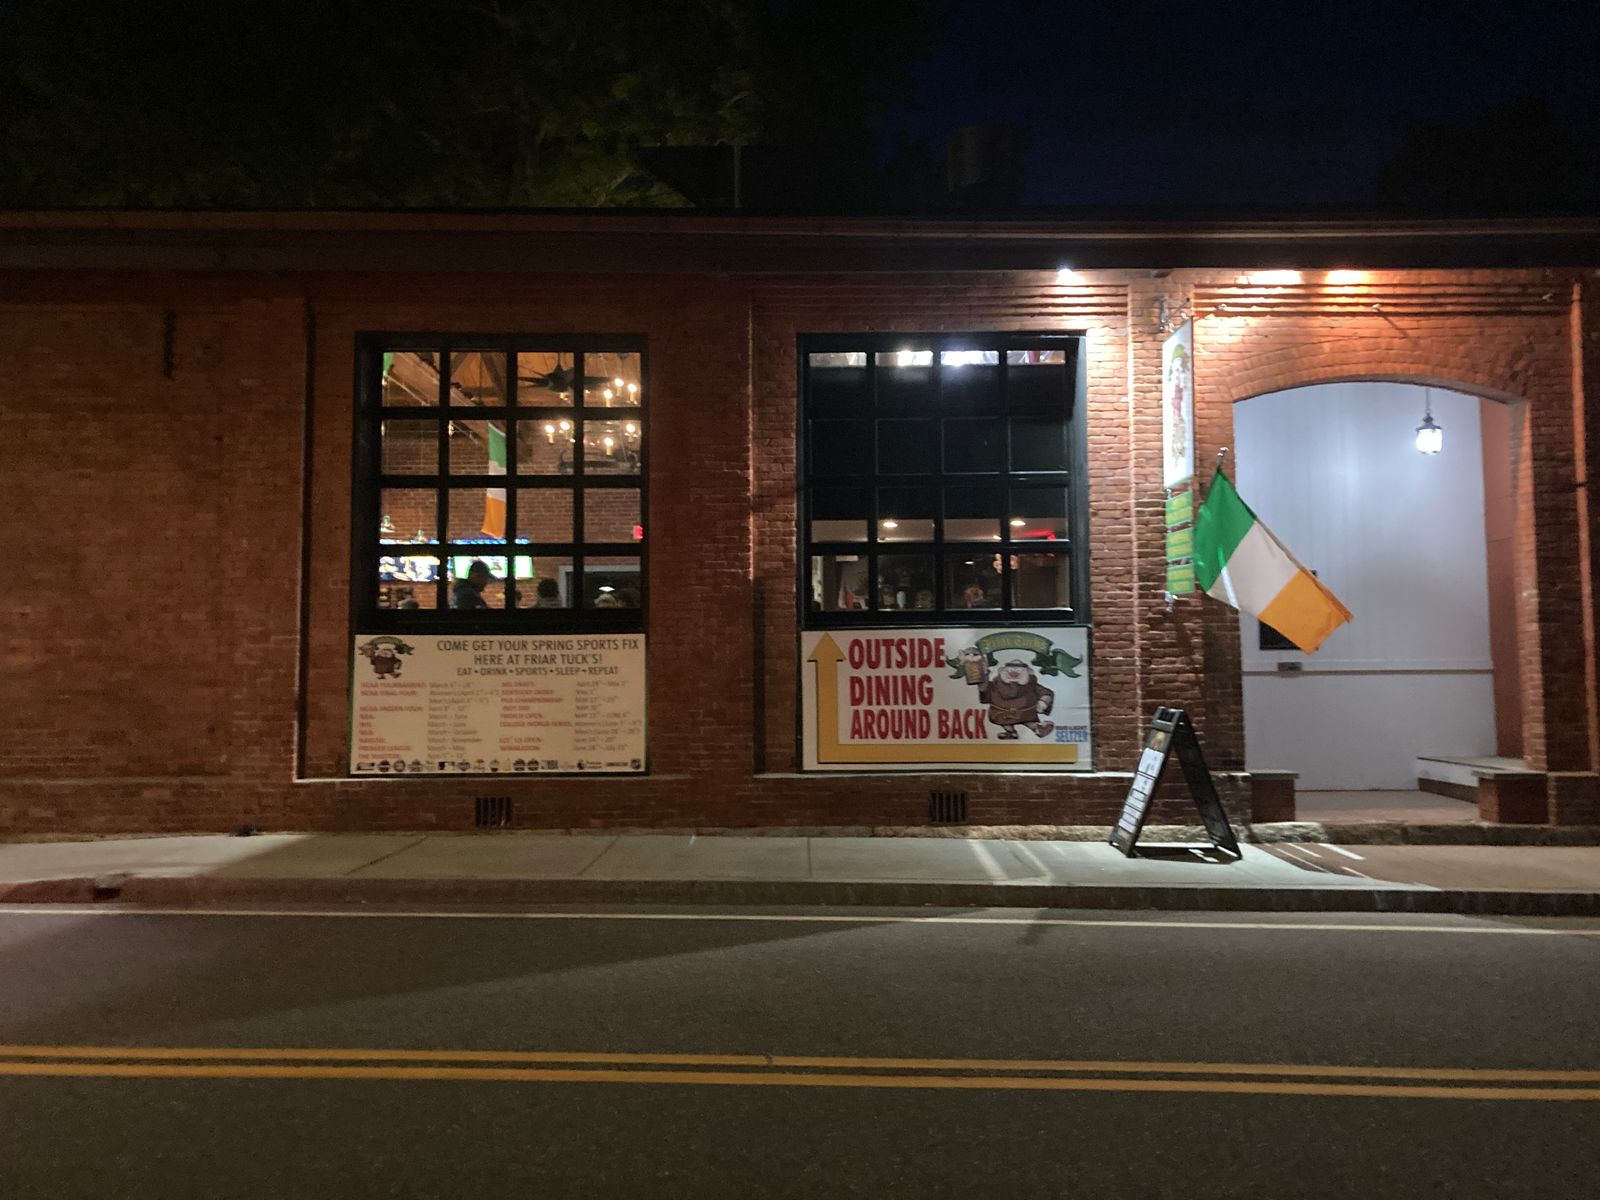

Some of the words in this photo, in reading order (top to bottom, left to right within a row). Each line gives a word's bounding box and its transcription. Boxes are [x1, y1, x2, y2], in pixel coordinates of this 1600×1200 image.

[436, 640, 468, 651] COME
[472, 640, 494, 650] GET
[497, 640, 529, 650] YOUR
[532, 640, 574, 650] SPRING
[577, 639, 619, 650] SPORTS
[622, 639, 640, 650] FIX
[849, 638, 946, 670] OUTSIDE
[474, 654, 503, 665] HERE
[506, 654, 521, 664] AT
[524, 654, 557, 664] FRIAR
[561, 653, 603, 664] TUCK'S!
[457, 667, 472, 676] EAT
[480, 667, 507, 676] DRINK
[515, 667, 548, 676] SPORTS
[555, 667, 581, 676] SLEEP
[587, 666, 619, 675] REPEAT
[850, 674, 934, 707] DINING
[850, 709, 931, 740] AROUND
[937, 709, 988, 740] BACK
